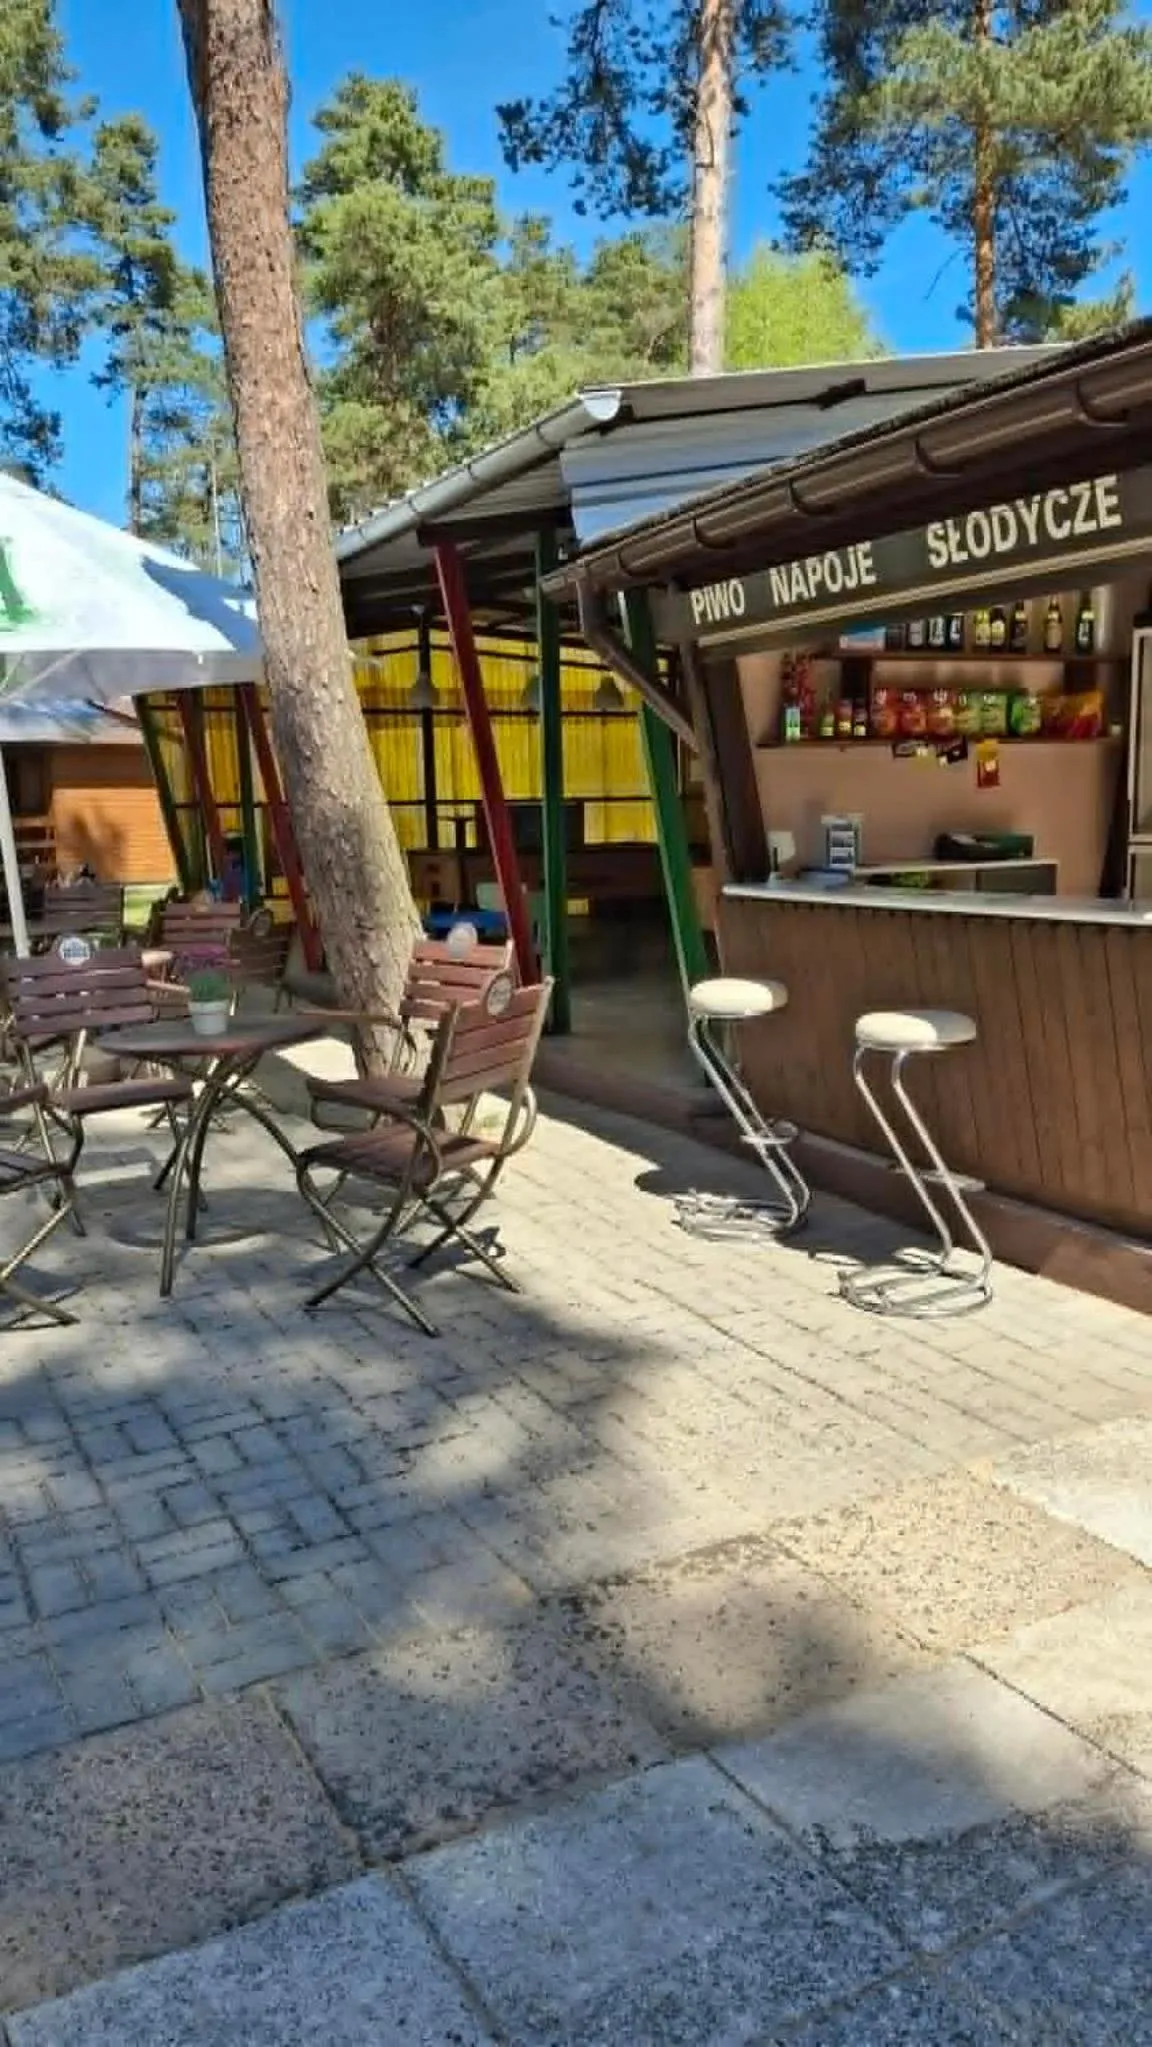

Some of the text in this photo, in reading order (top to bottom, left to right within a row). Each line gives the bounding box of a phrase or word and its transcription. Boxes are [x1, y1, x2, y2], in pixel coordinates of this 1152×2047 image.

[689, 474, 1122, 625] PIWO NAPOJE SŁODYCZE
